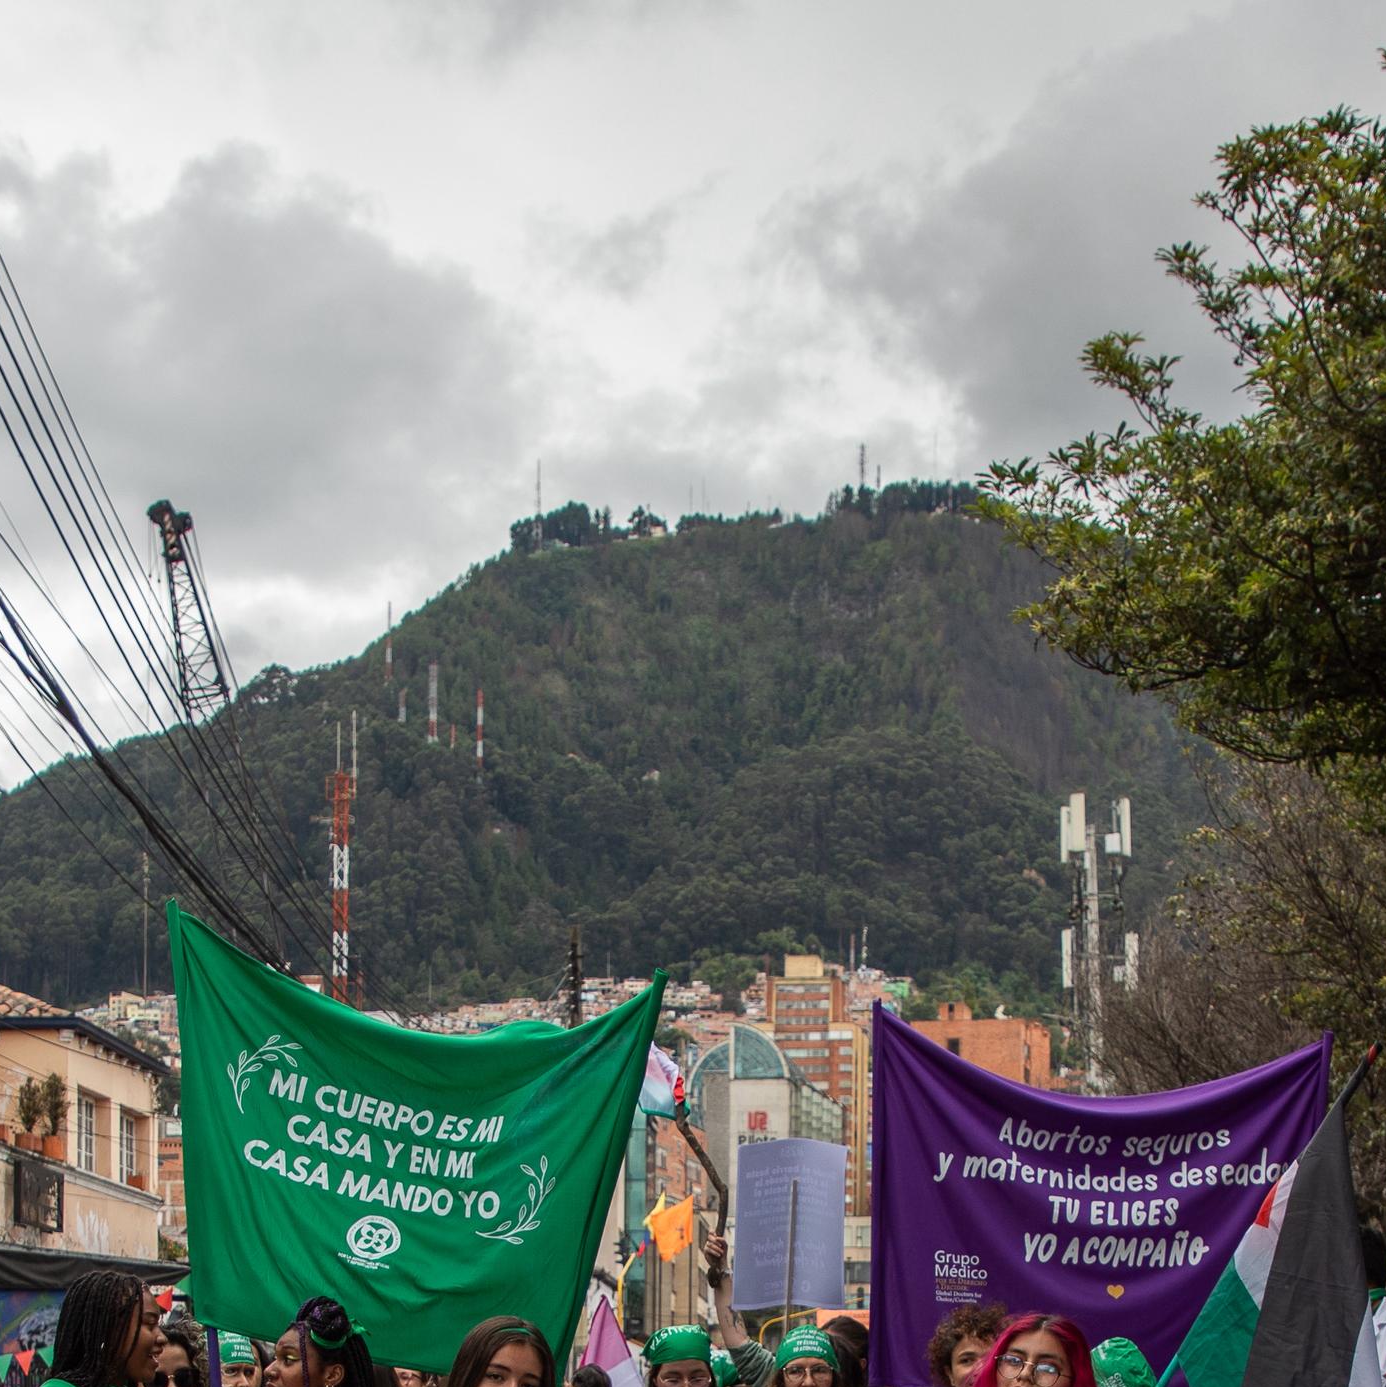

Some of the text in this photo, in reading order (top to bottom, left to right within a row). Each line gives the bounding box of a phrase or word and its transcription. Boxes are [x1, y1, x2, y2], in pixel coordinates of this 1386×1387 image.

[268, 1068, 504, 1143] MI CUERPO ES MI
[286, 1114, 476, 1179] CASA Y EN MI
[998, 1117, 1231, 1165] Abortos seguros
[243, 1139, 500, 1219] CASA MANDO YO
[933, 1152, 954, 1182] y
[963, 1152, 1158, 1193] maternidades
[1048, 1195, 1179, 1226] TU ELIGES
[934, 1250, 979, 1267] Grupo
[1023, 1230, 1210, 1268] YO ACOMPAÑO
[935, 1264, 988, 1280] Médico
